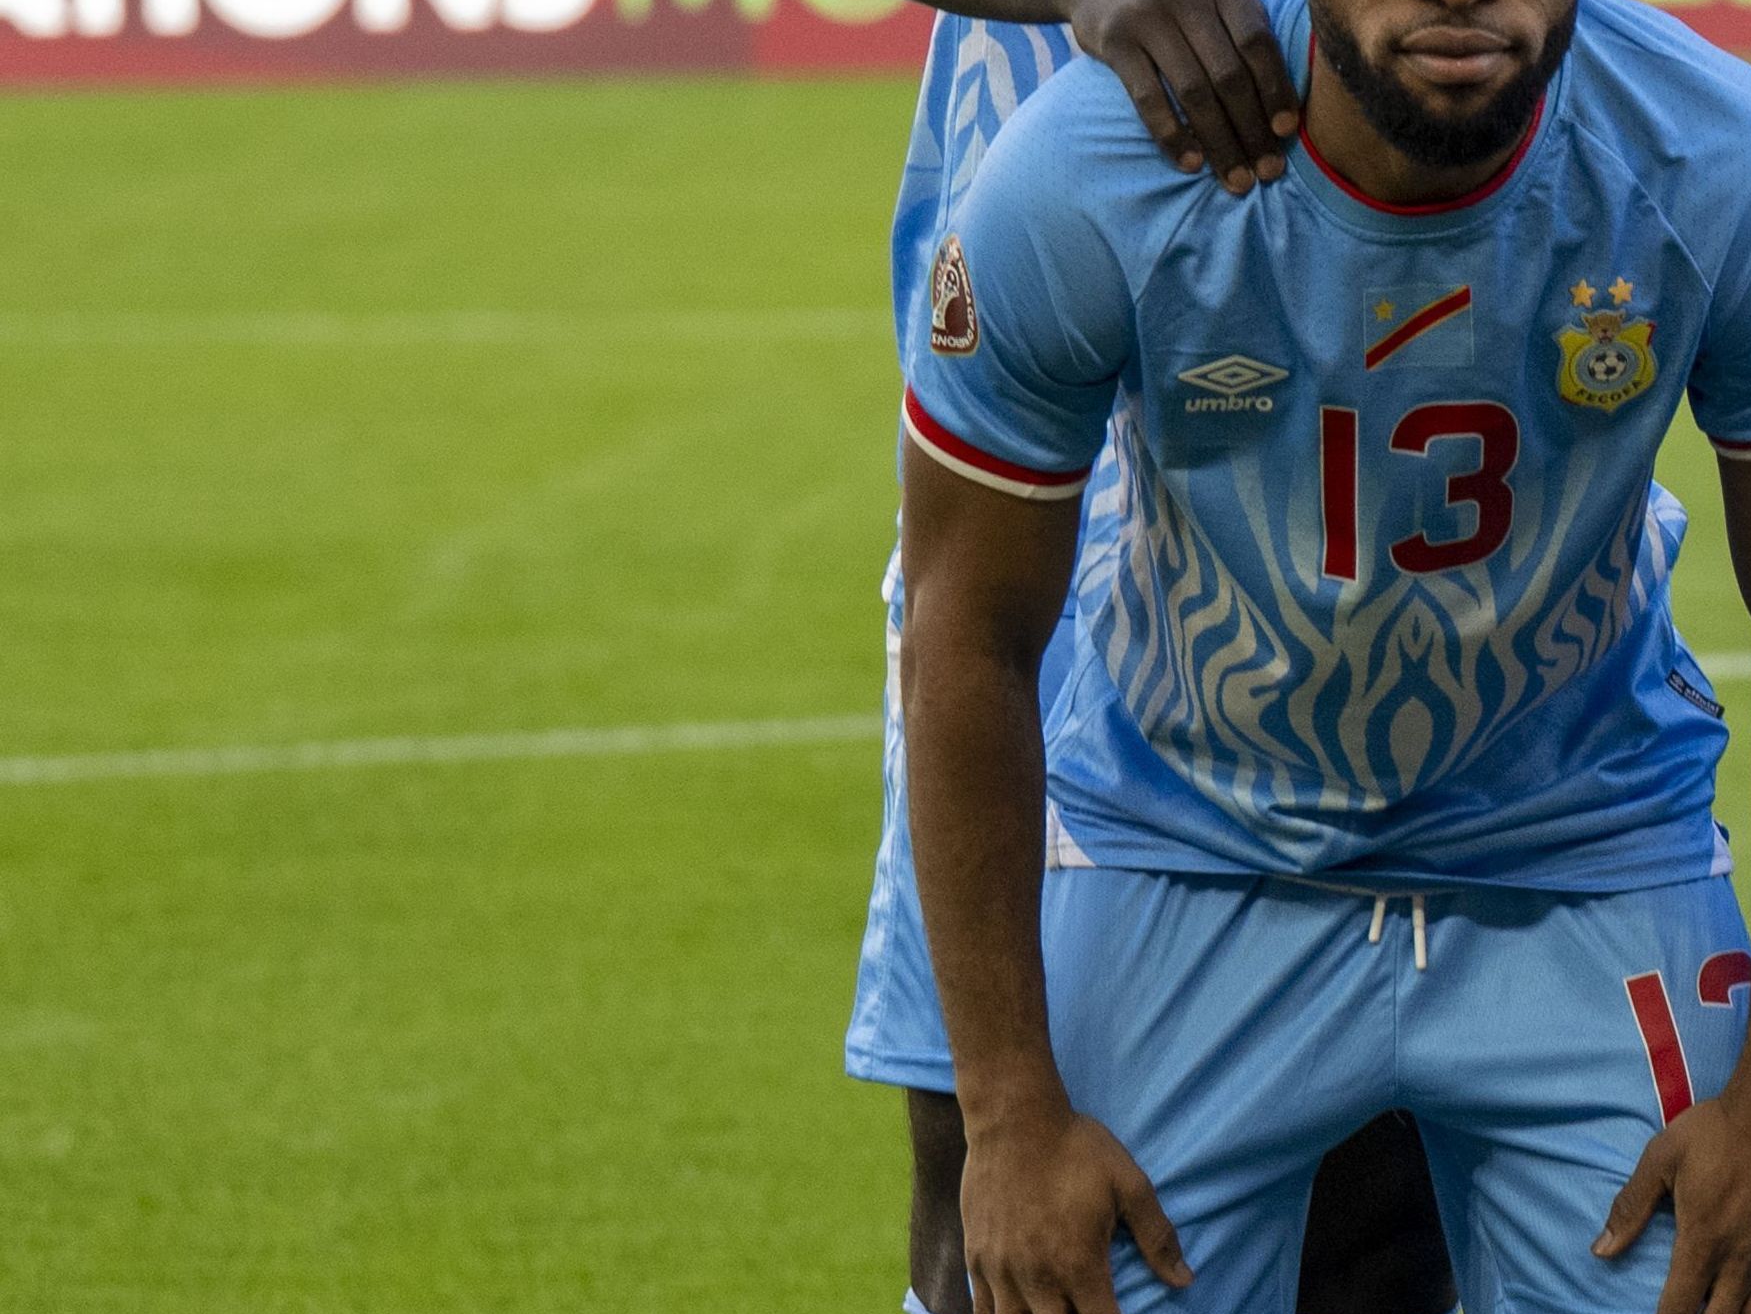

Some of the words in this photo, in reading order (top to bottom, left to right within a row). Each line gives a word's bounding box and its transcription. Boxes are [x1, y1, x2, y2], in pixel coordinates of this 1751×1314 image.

[1185, 393, 1273, 413] umbro
[1576, 380, 1640, 404] FECOFA
[1319, 400, 1519, 583] 13
